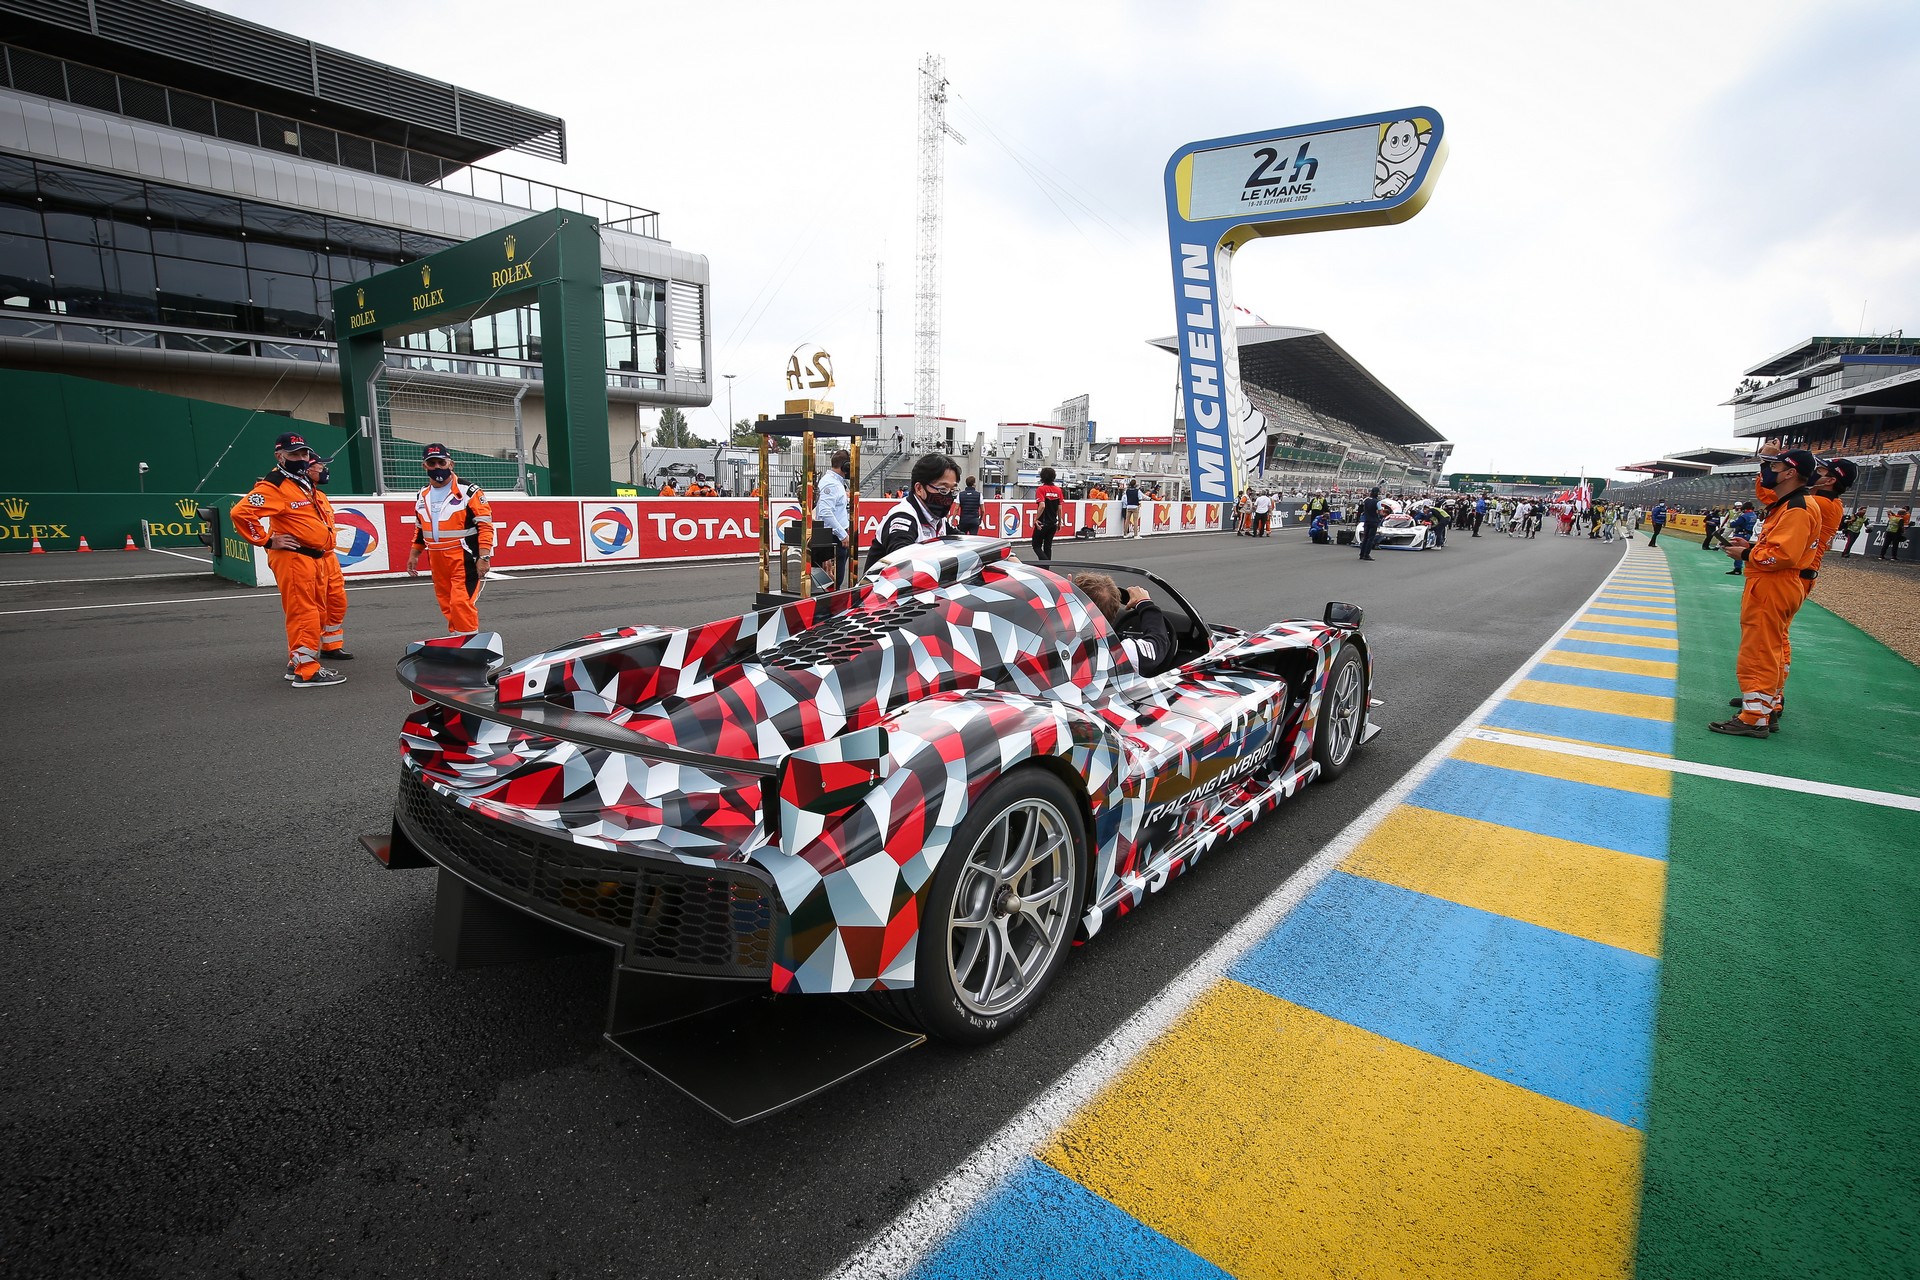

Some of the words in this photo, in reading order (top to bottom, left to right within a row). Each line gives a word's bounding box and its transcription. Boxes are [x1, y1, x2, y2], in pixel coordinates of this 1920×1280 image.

[1244, 141, 1319, 189] 24h
[1240, 189, 1262, 202] LE
[1263, 183, 1312, 199] MANS
[1263, 197, 1293, 206] SEPTEMBRE
[491, 261, 533, 289] ROLEX
[412, 288, 445, 312] ROLEX
[350, 309, 376, 329] ROLEX
[1180, 242, 1227, 498] MICHELIN
[0, 524, 71, 540] OLEX
[149, 522, 212, 536] ROLE
[648, 513, 760, 542] TOTAL
[224, 537, 250, 563] ROLEX
[1144, 780, 1216, 829] RACING
[1217, 740, 1273, 786] HYBRID
